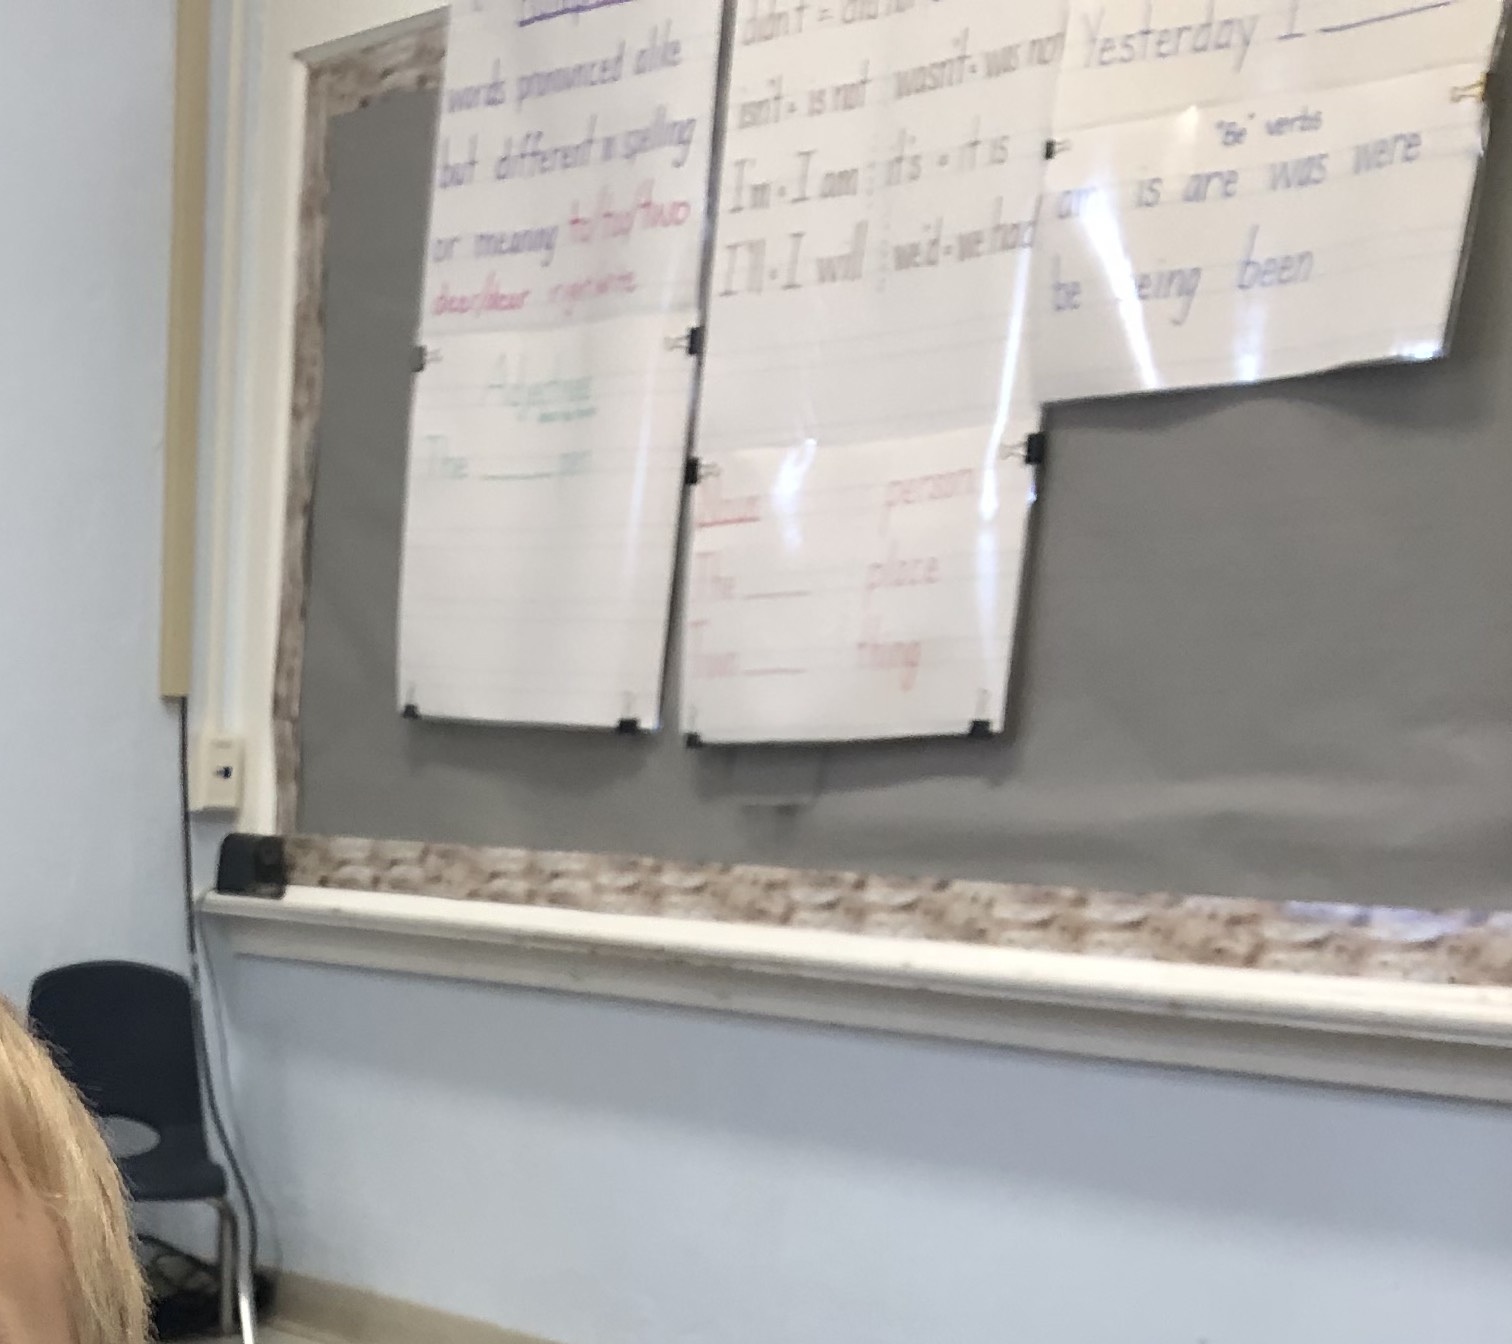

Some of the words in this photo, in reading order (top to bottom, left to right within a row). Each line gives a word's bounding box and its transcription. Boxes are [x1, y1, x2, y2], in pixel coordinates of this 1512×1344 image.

[1085, 0, 1259, 73] Yesterday
[440, 135, 478, 189] but
[495, 114, 598, 180] different
[1265, 105, 1322, 136] verbs
[1135, 177, 1163, 207] is
[1183, 170, 1239, 203] are
[1270, 153, 1329, 191] was
[1353, 132, 1422, 175] were
[1052, 254, 1081, 311] be
[1134, 260, 1201, 326] eing
[1237, 224, 1313, 291] been
